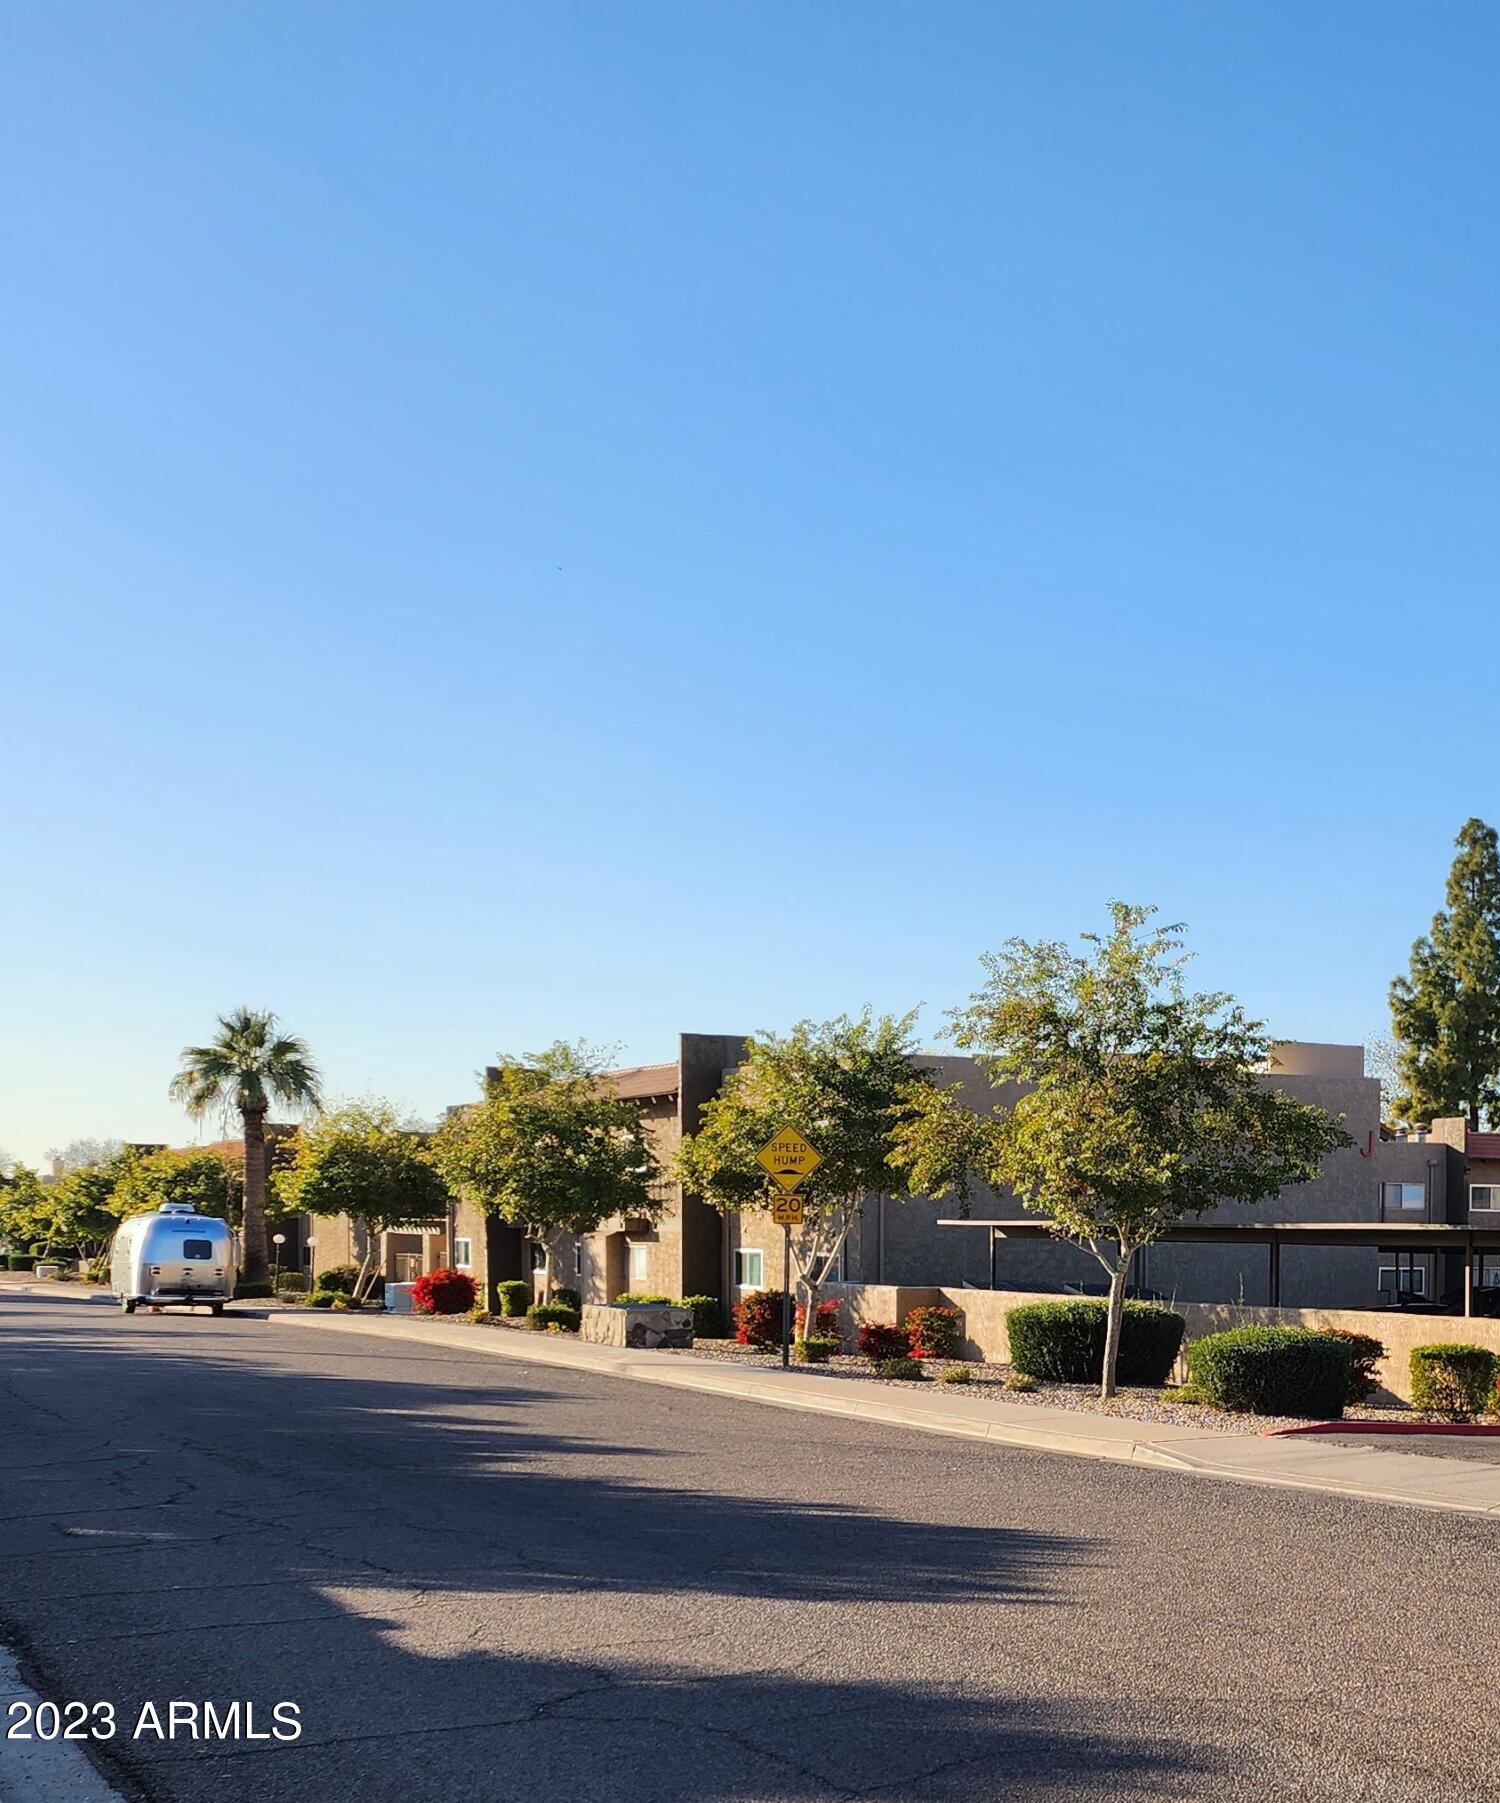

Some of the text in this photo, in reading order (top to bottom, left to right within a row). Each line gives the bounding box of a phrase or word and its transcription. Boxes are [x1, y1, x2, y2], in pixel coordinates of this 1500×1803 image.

[771, 1143, 807, 1153] SPEED
[773, 1155, 805, 1166] HUMP
[776, 1197, 801, 1213] 20
